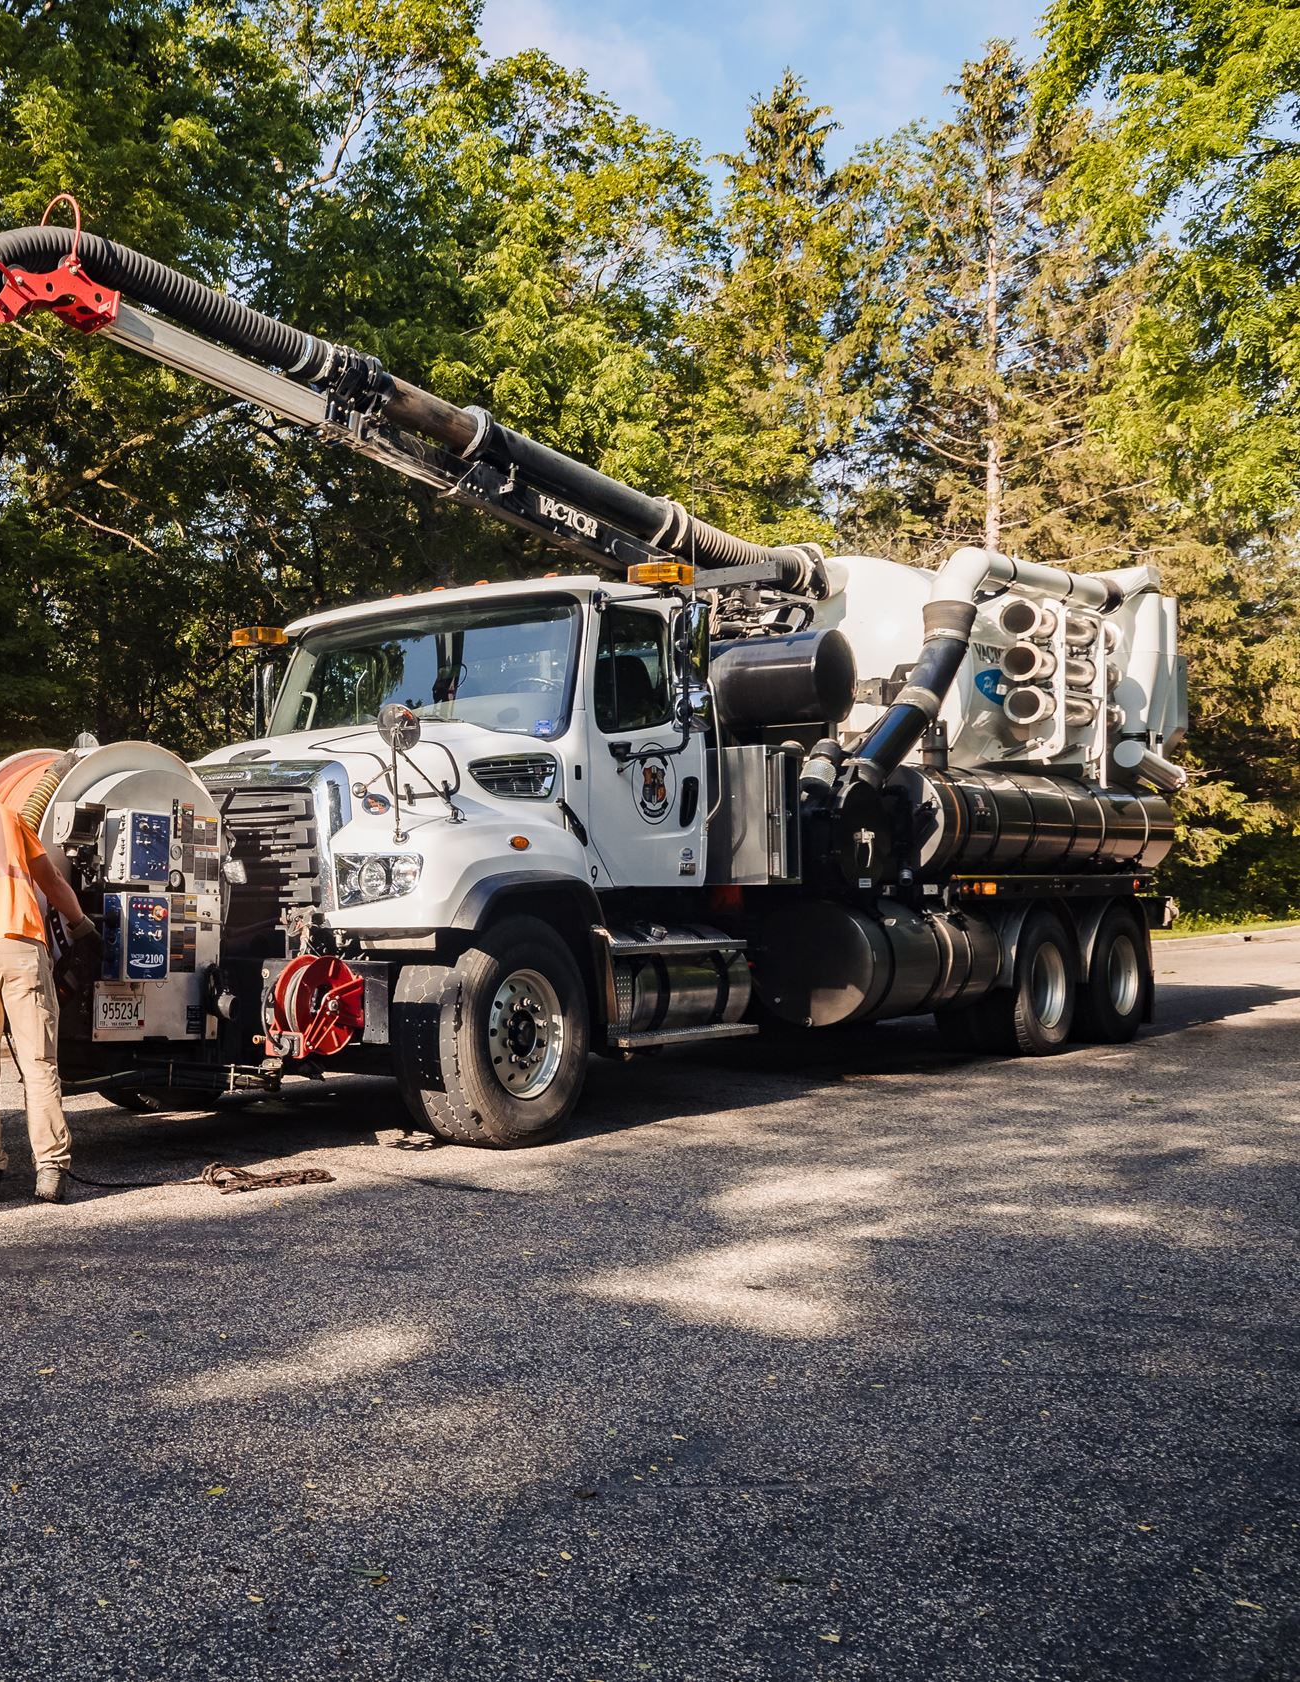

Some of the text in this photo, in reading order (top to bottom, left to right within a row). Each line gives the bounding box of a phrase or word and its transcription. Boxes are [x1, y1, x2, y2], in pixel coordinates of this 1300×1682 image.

[539, 494, 598, 538] VACTOR
[590, 865, 598, 885] 9
[145, 953, 164, 964] 2100
[102, 1002, 140, 1020] 955234
